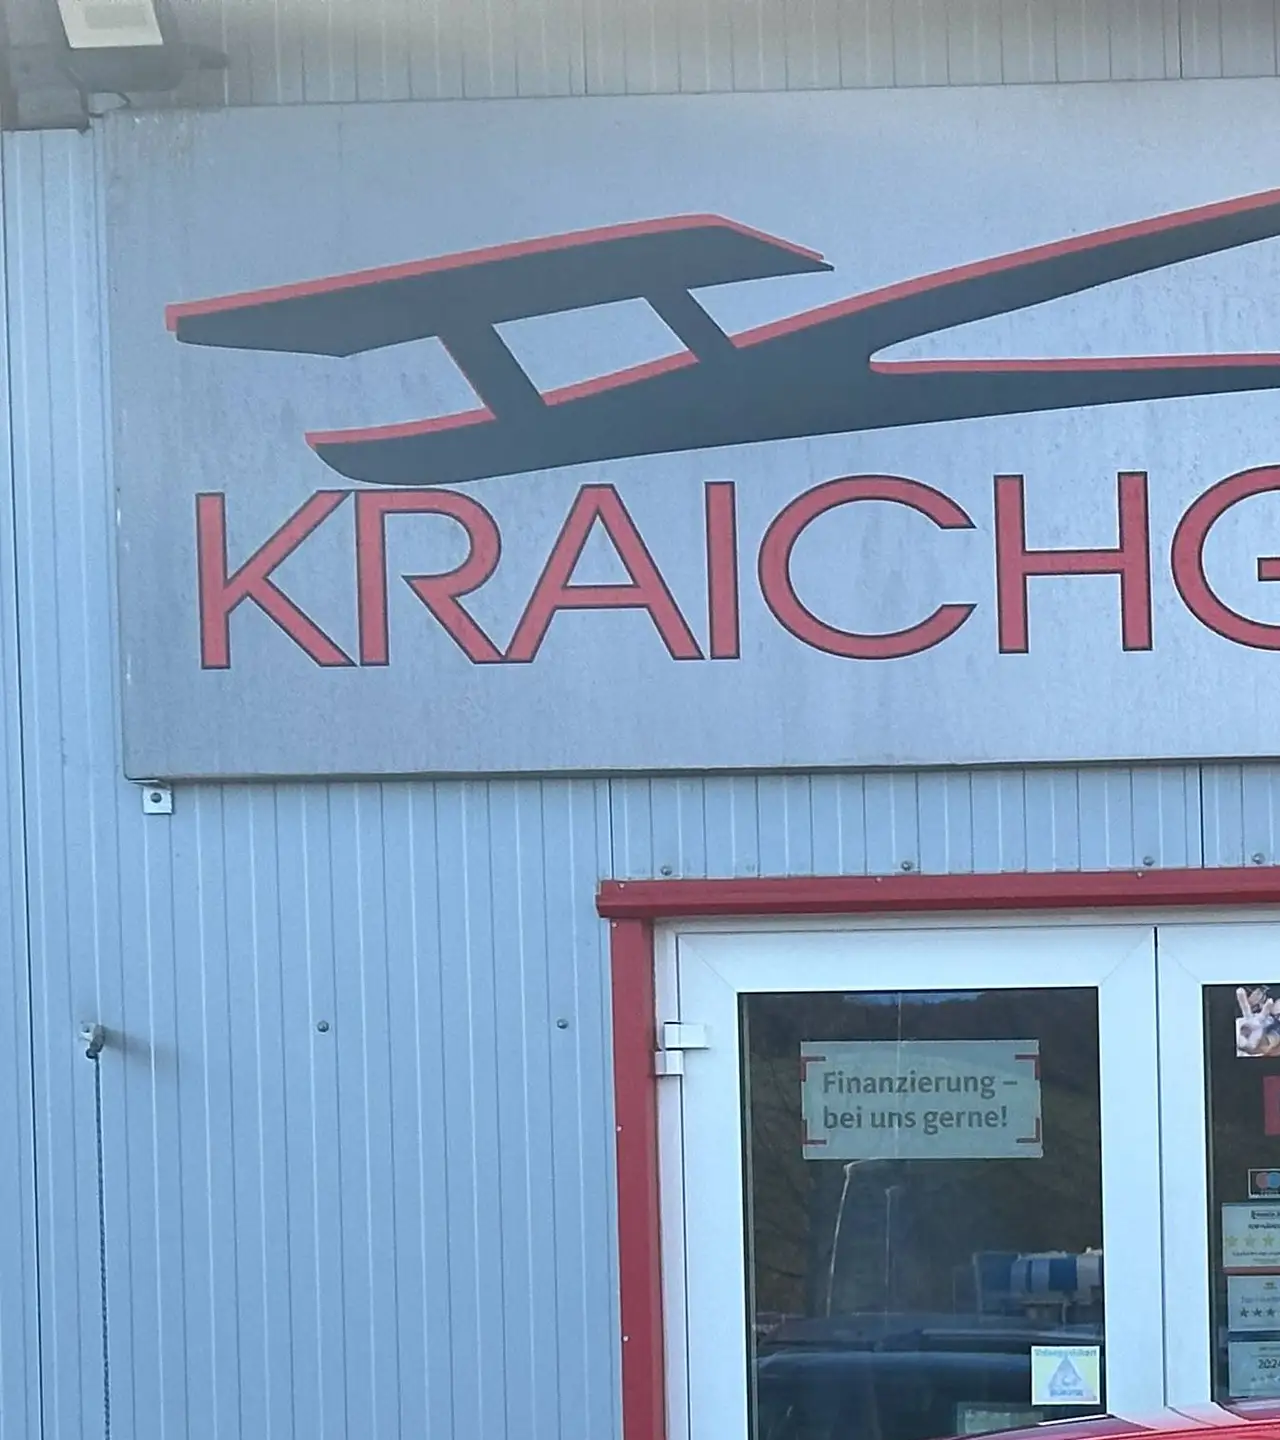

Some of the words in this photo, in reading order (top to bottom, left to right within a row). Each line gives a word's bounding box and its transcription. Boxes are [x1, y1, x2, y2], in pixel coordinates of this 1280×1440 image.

[823, 1070, 996, 1100] Finanzierung
[823, 1106, 862, 1129] bei
[870, 1110, 917, 1129] uns
[923, 1105, 1008, 1136] gerne!
